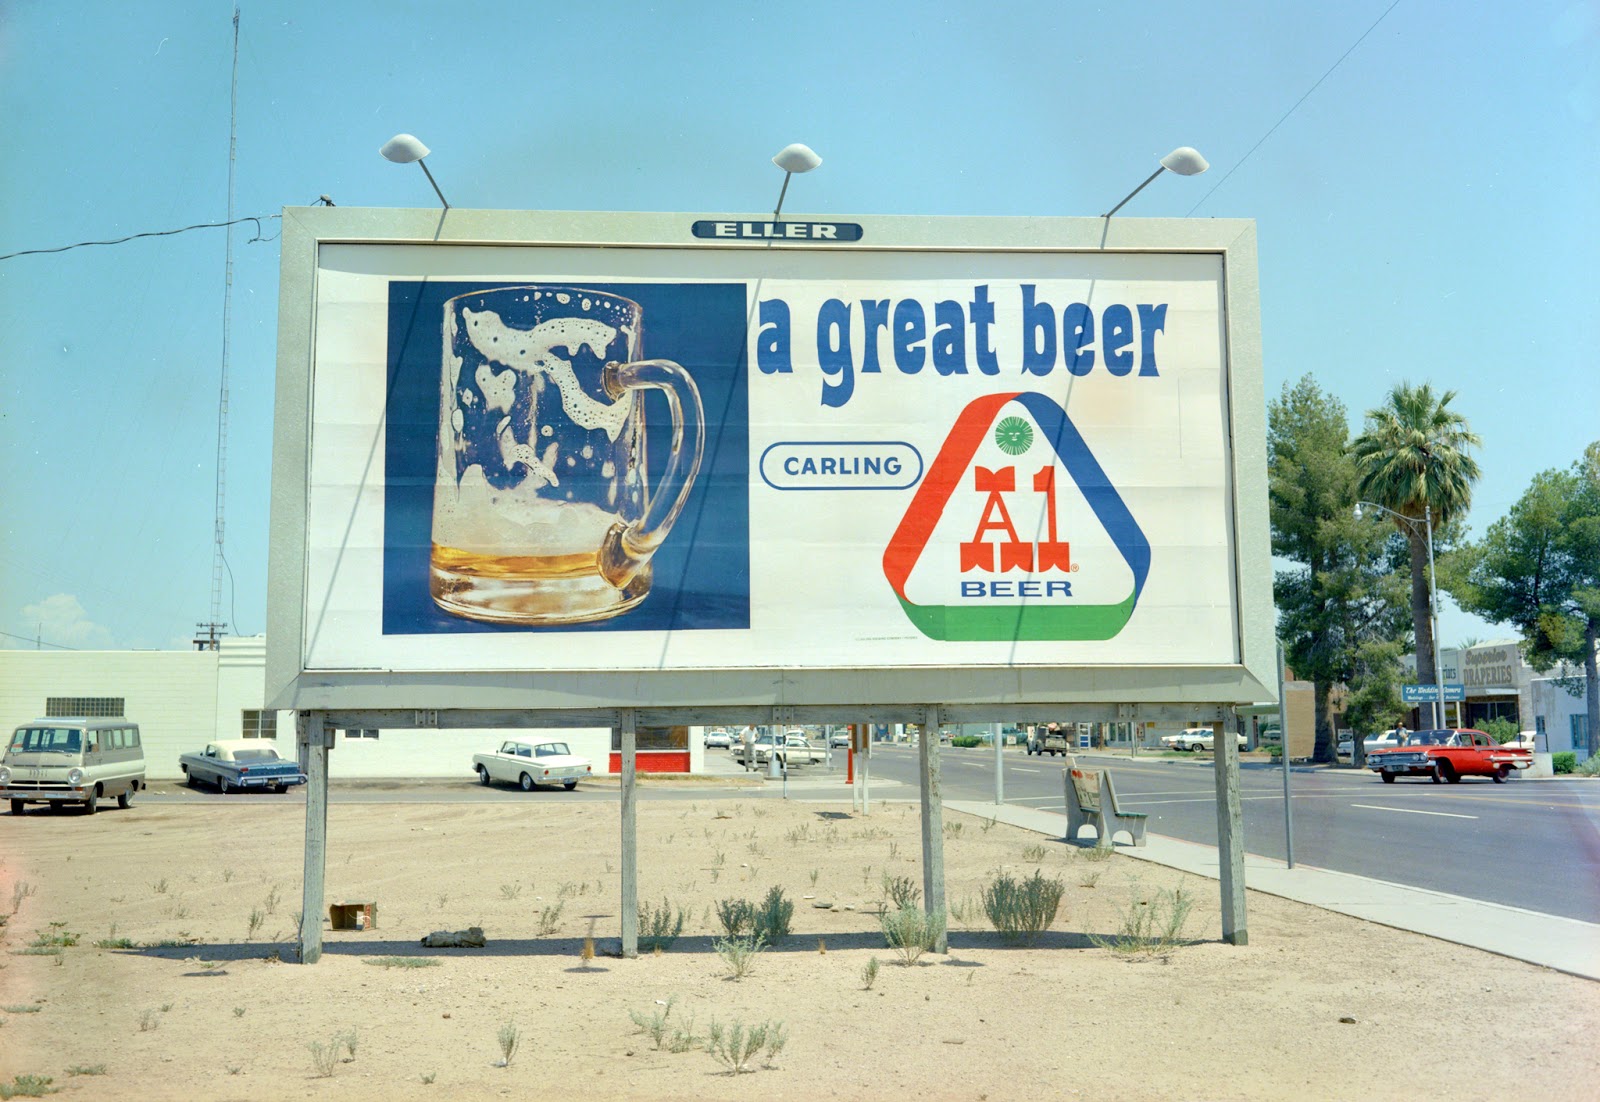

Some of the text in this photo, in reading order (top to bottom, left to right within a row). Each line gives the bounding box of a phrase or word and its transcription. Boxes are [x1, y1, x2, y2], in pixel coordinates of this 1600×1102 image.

[715, 222, 837, 239] ELLER
[757, 284, 1168, 408] a great beer
[784, 456, 902, 476] CARLING
[961, 580, 1073, 597] BEER
[1465, 648, 1508, 667] Superior
[1463, 665, 1512, 686] DRAPERIES
[1417, 686, 1439, 695] Weddin
